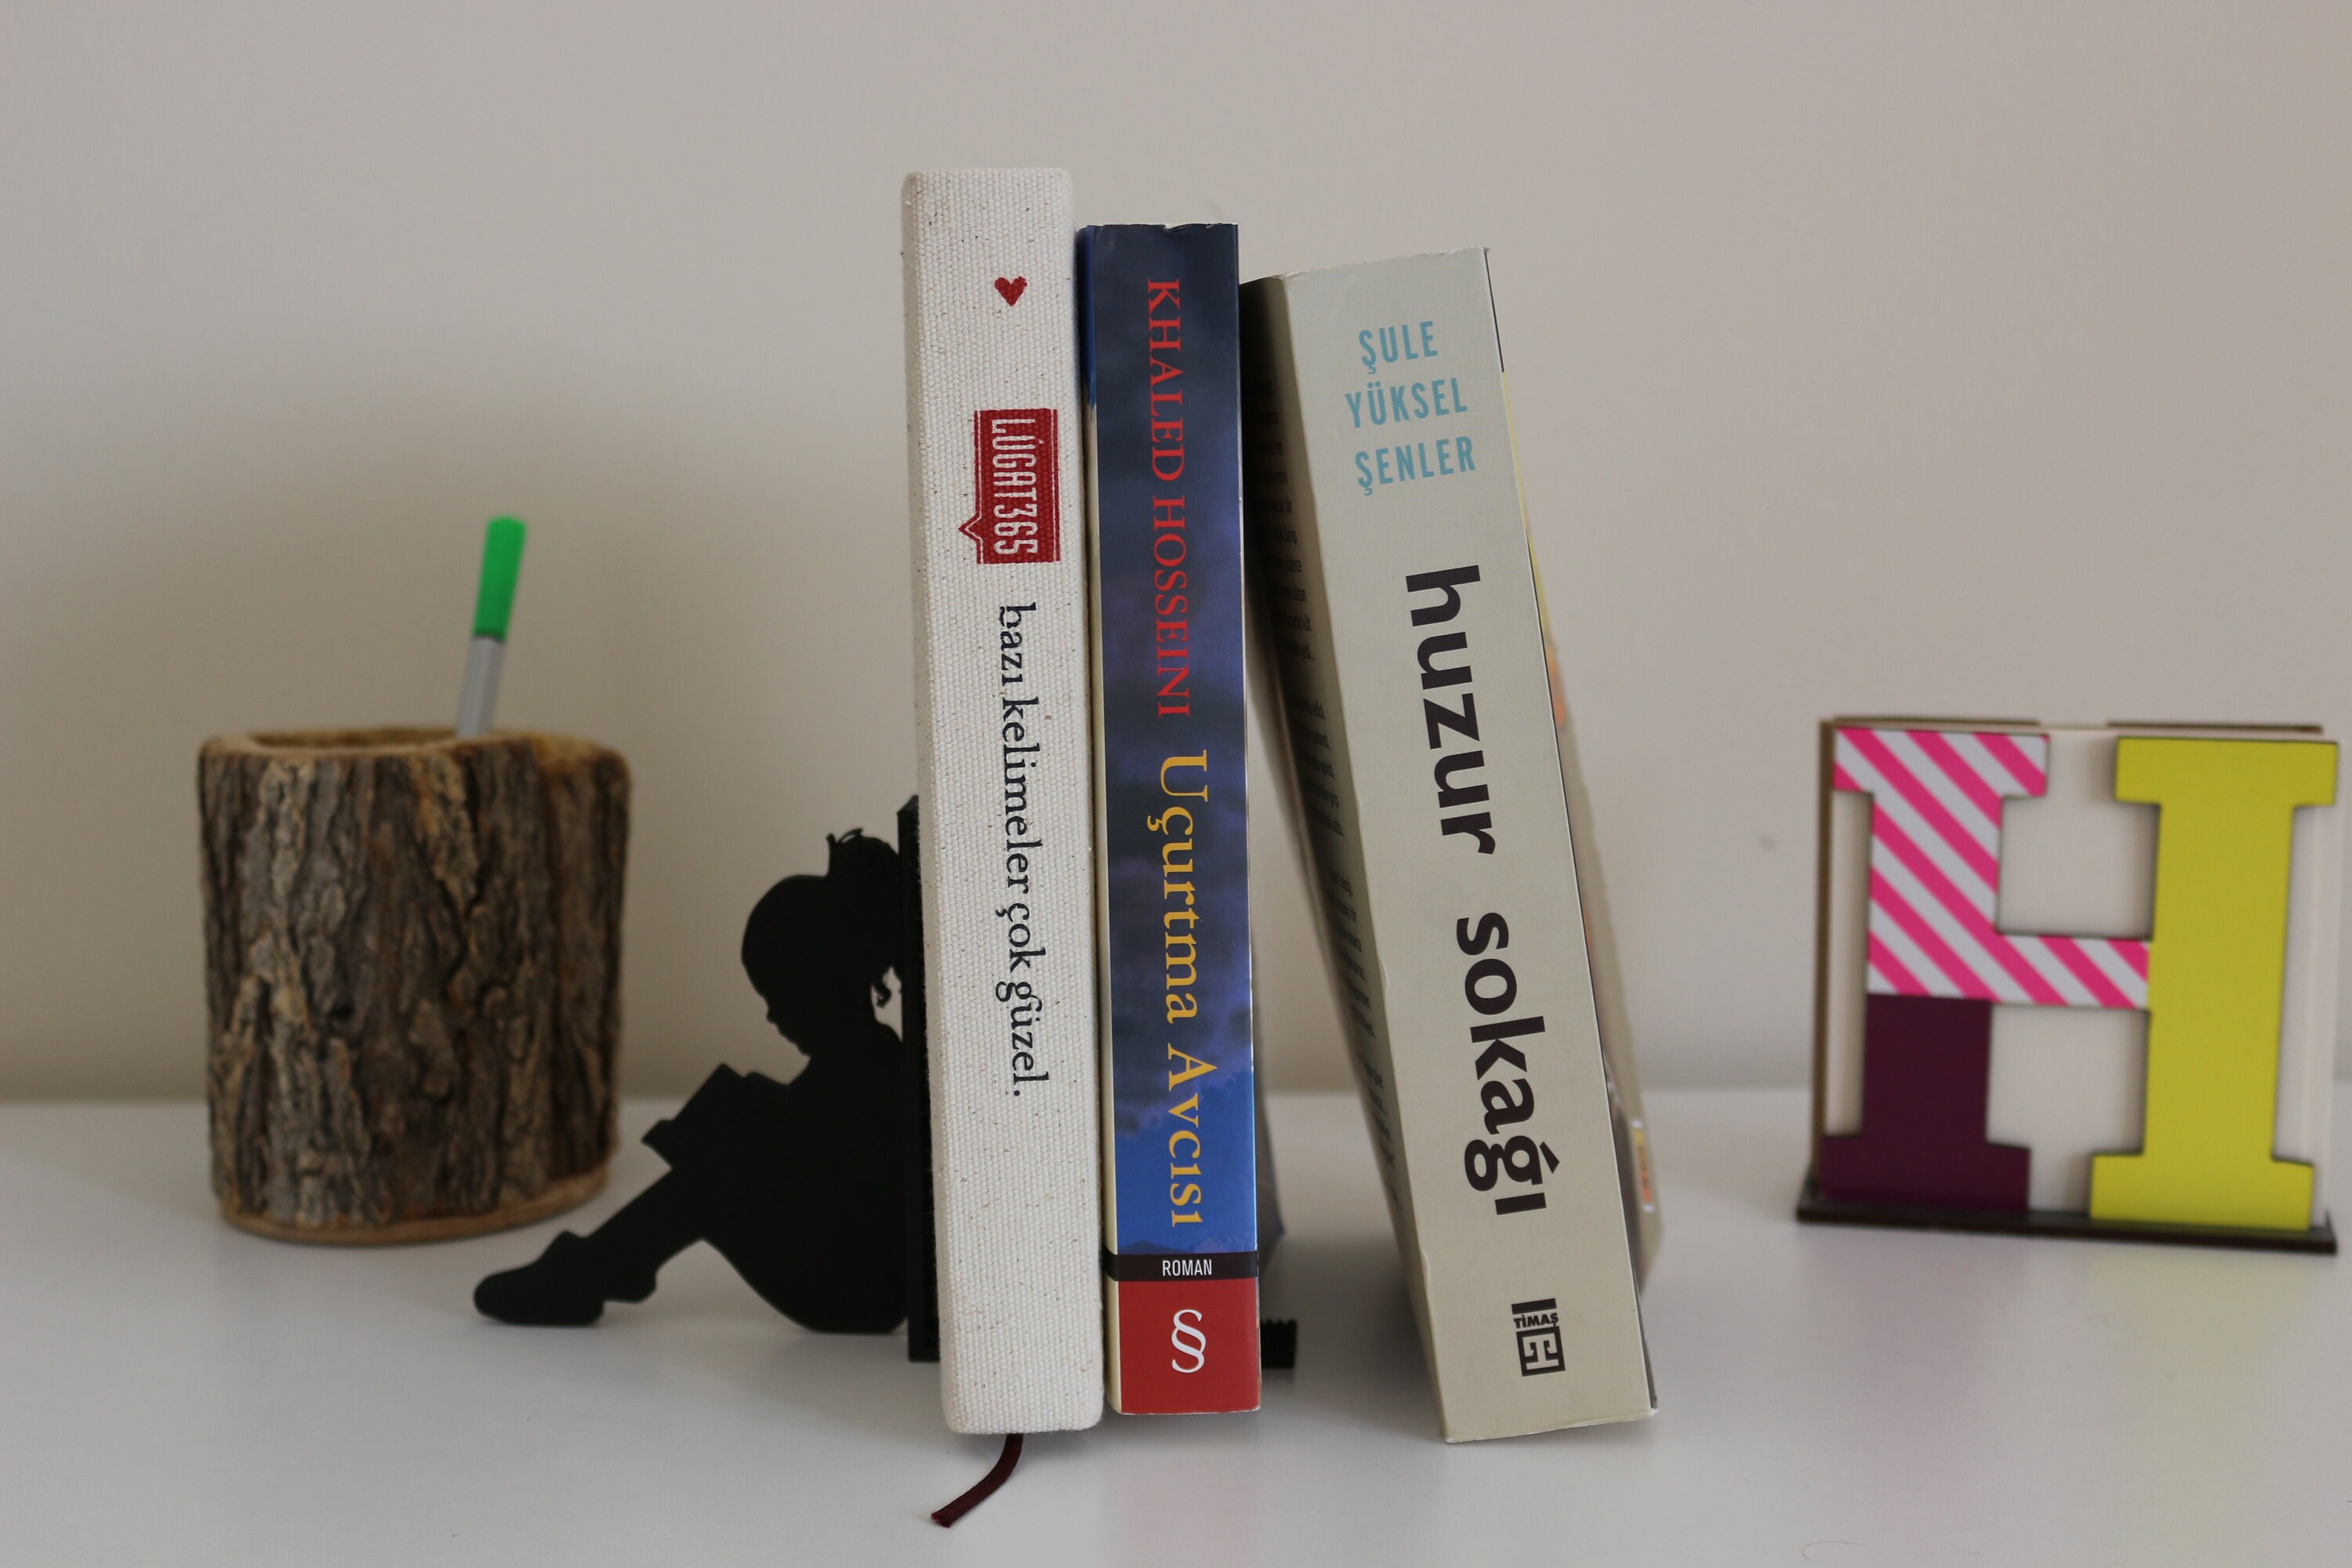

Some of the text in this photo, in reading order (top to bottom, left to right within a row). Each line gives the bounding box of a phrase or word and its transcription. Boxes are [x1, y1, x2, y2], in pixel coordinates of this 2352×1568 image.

[1358, 321, 1438, 374] ŞULE
[1345, 378, 1468, 428] YÜKSEL
[1355, 436, 1475, 495] ŞENLER
[1147, 280, 1190, 717] KHALED HOSSEINI
[1406, 564, 1497, 855] huzur
[995, 601, 1050, 1097] bazı kelimeler çok güzel.
[1146, 750, 1217, 1225] Uçurtma Avcısı
[1162, 1259, 1212, 1276] ROMAN
[1513, 1312, 1559, 1328] TİMAŞ
